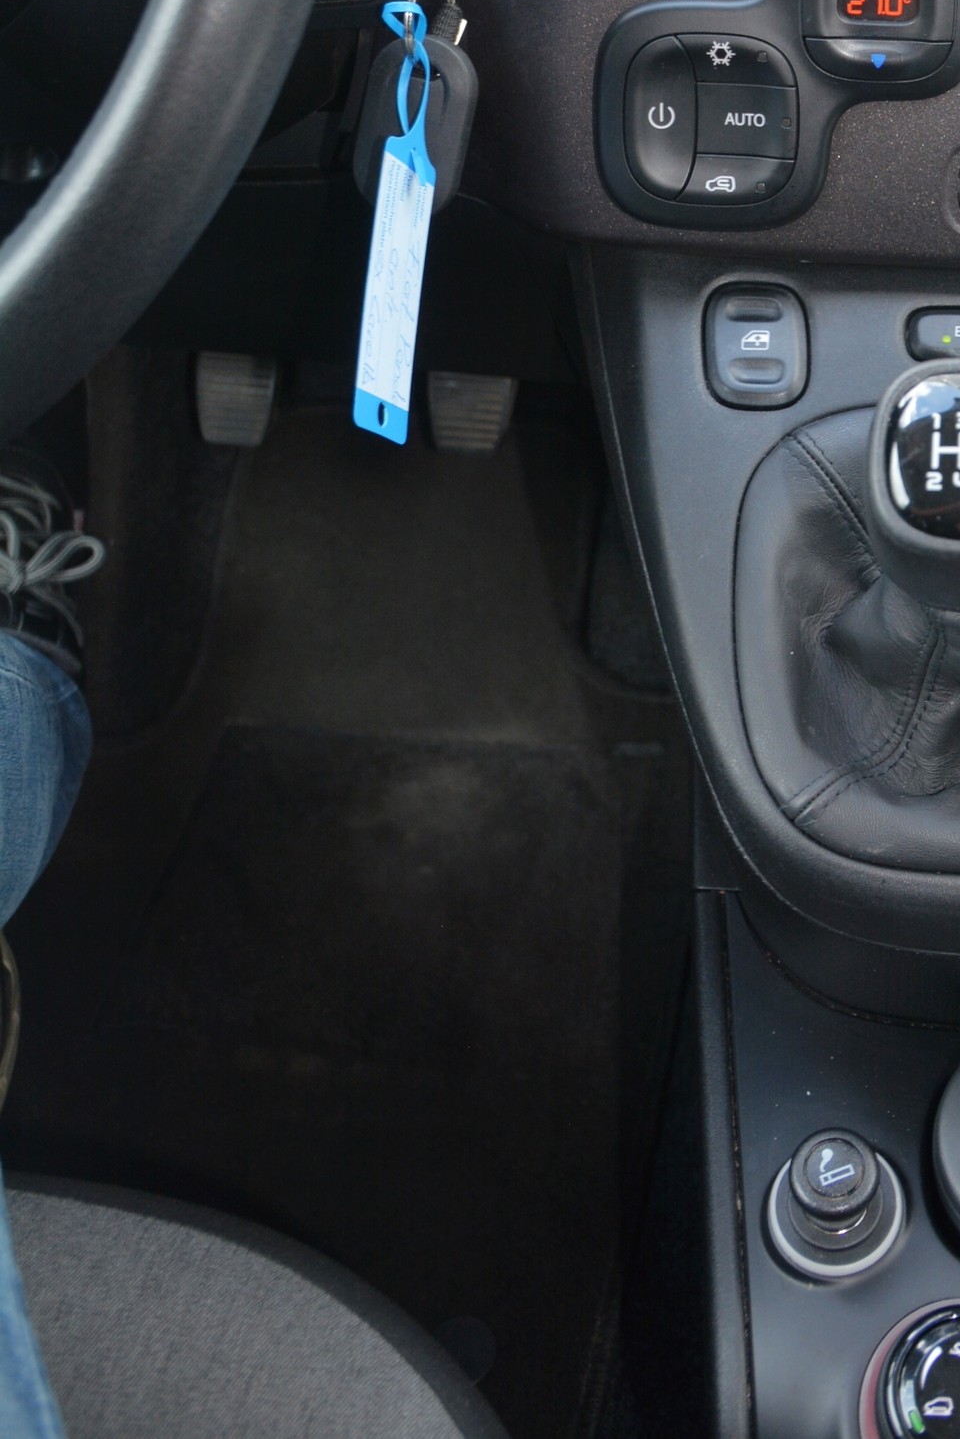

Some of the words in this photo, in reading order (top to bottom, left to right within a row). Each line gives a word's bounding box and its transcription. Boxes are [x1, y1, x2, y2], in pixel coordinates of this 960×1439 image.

[724, 112, 766, 128] AUTO
[931, 412, 942, 430] 1
[925, 471, 943, 491] 2
